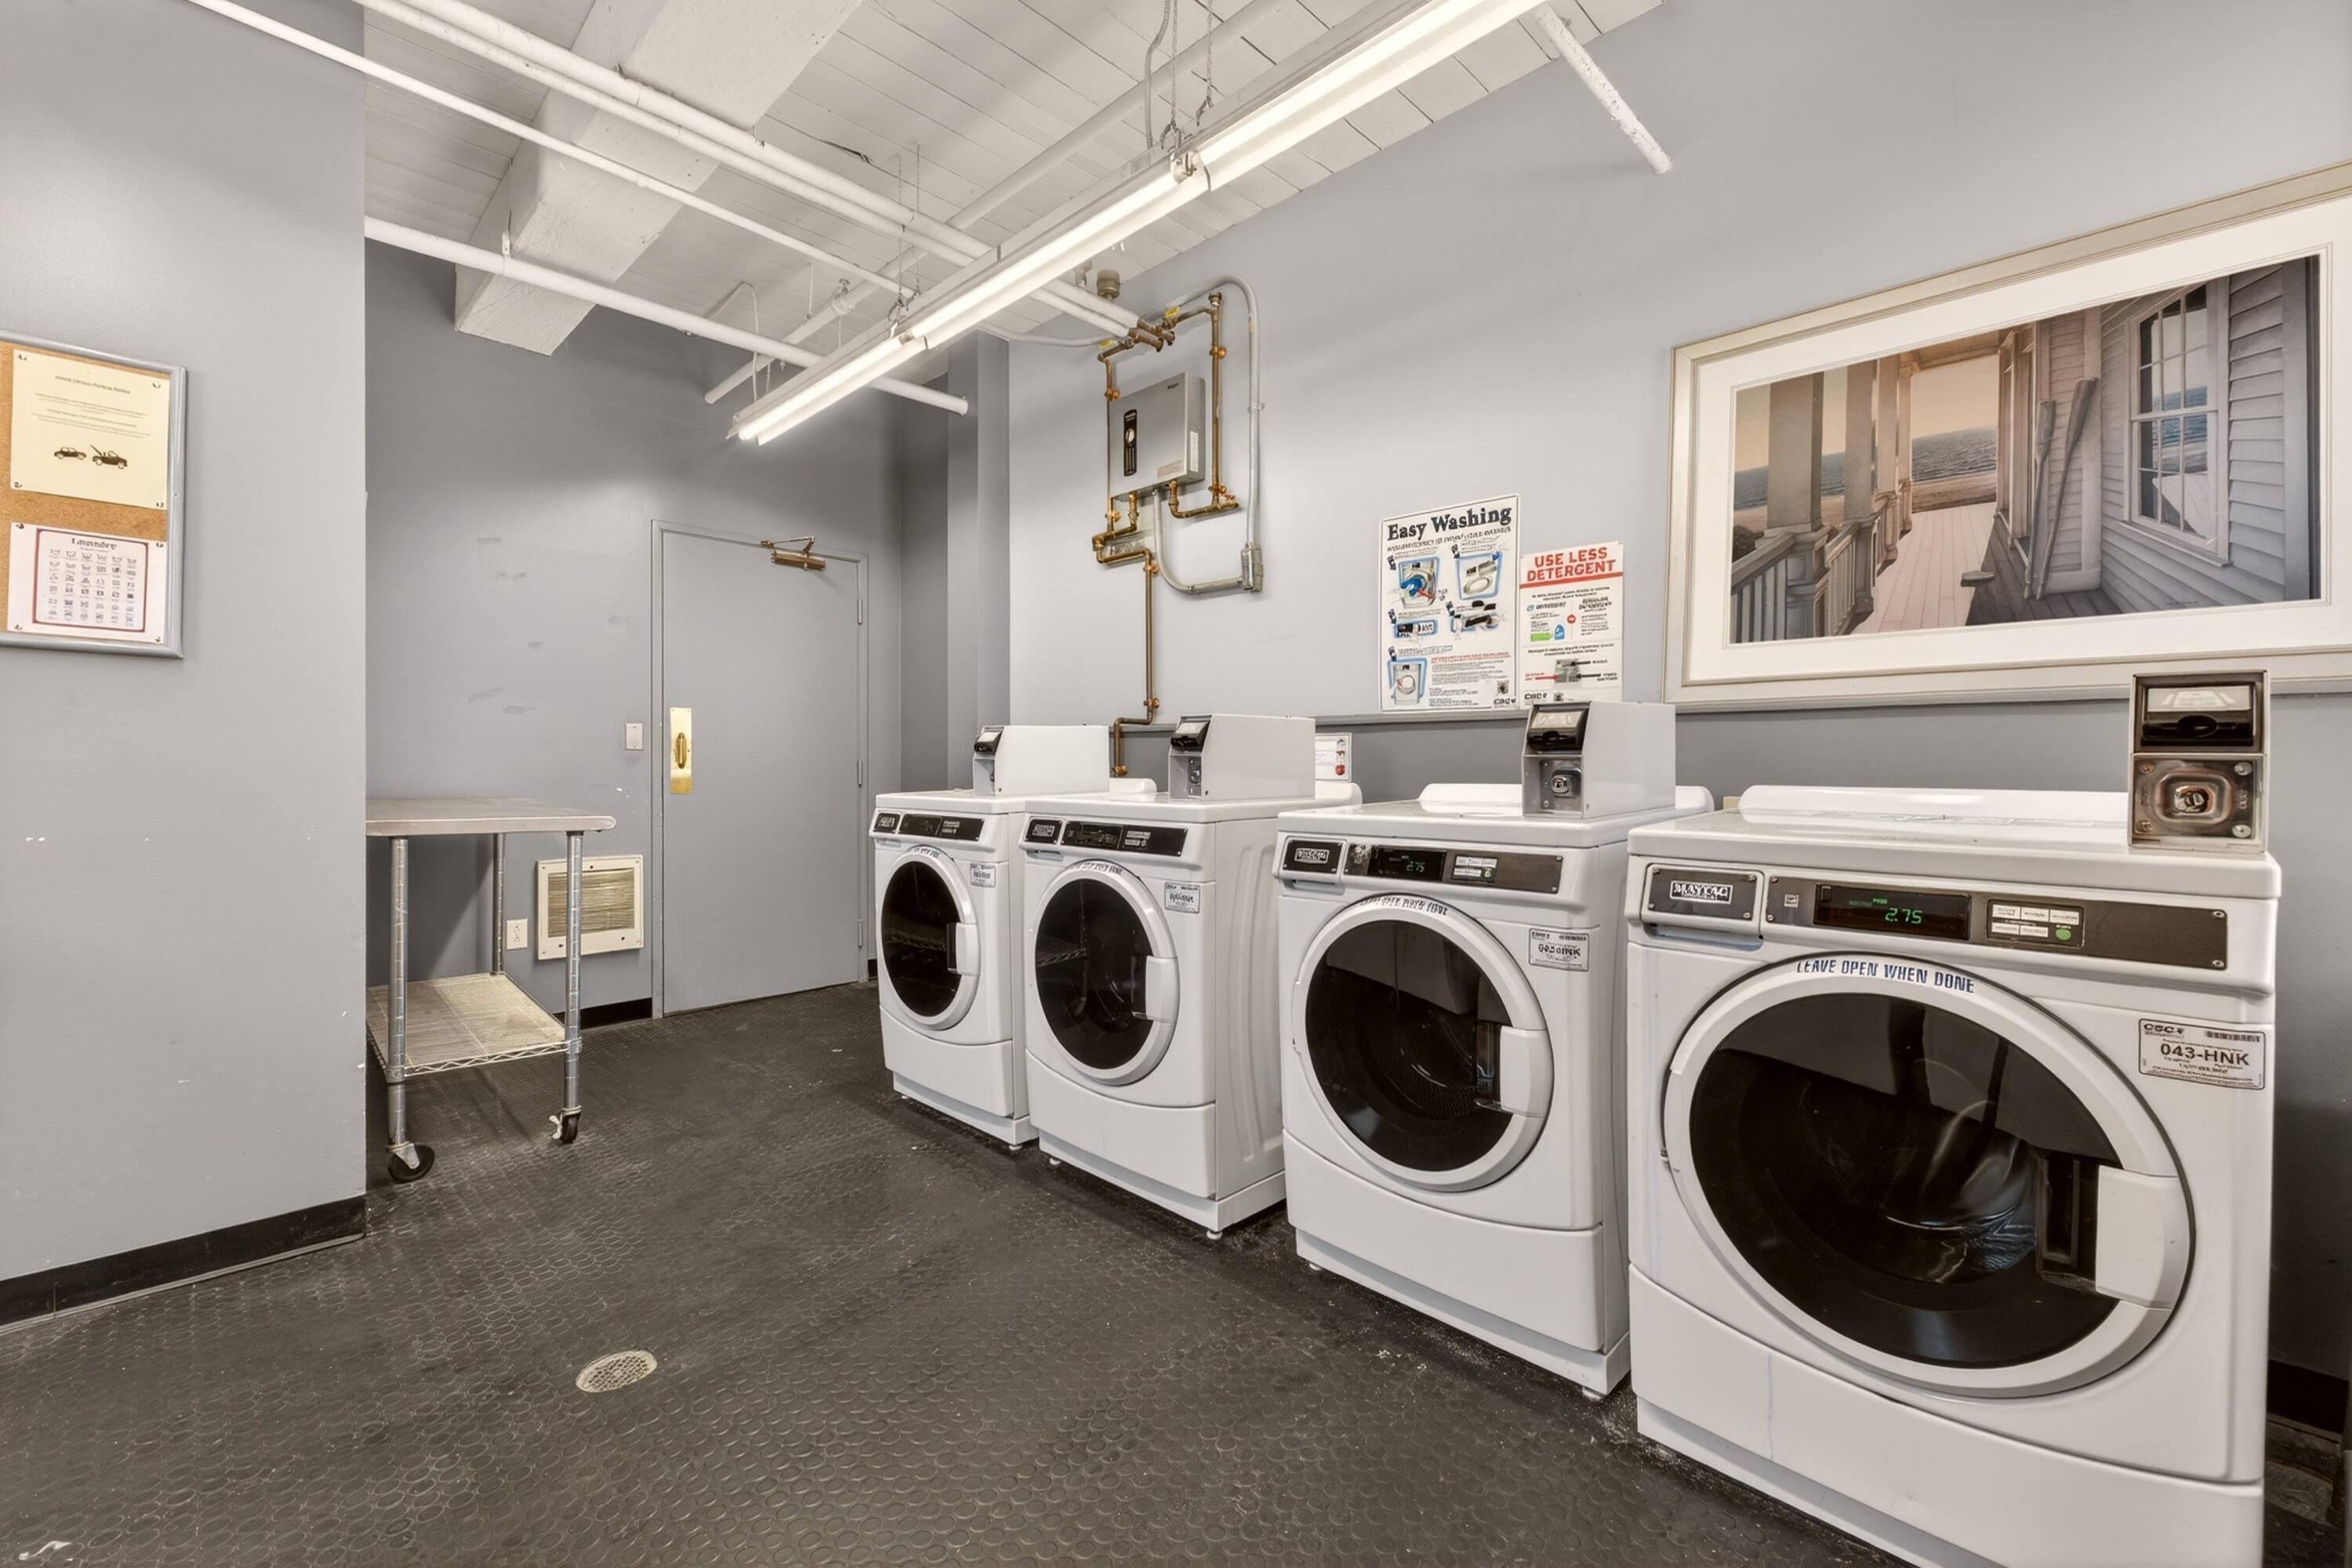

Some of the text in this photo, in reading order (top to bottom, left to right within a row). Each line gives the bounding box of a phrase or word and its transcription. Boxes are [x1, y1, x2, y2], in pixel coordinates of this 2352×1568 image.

[1387, 523, 1427, 541] Easy
[1431, 507, 1512, 533] Washing
[1534, 546, 1607, 568] USE LESS
[1526, 559, 1617, 582] DETERGENT
[1885, 907, 1923, 924] 2.75
[1796, 959, 1975, 994] LEAVE OPEN WHEN DONE
[2160, 1043, 2249, 1066] 043-HNK
